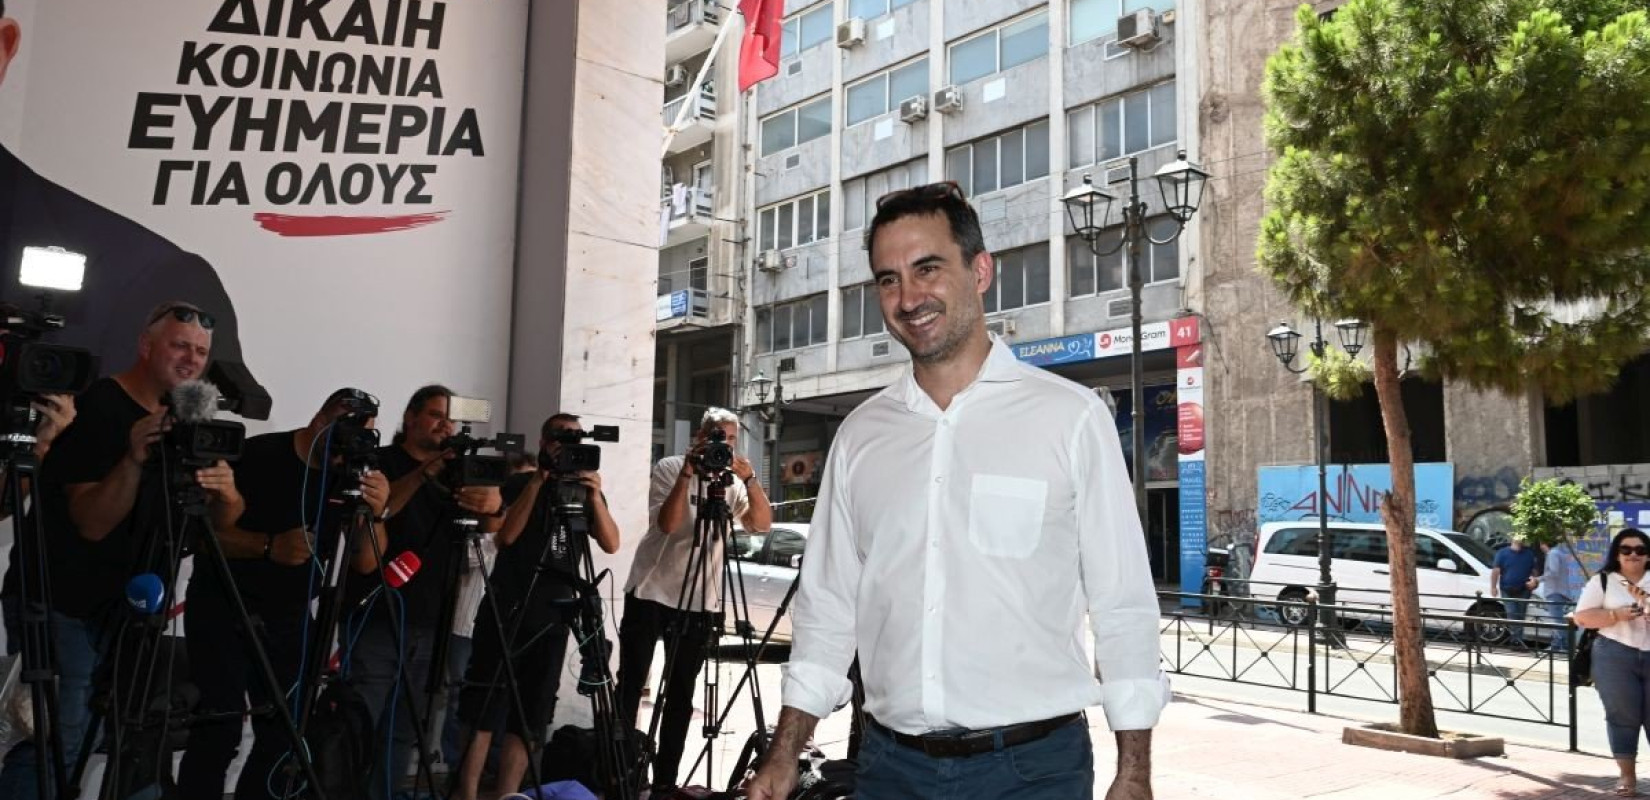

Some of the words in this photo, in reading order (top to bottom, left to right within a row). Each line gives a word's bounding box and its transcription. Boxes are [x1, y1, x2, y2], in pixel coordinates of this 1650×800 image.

[207, 0, 446, 49] ΔΙΚΑΙΗ
[176, 41, 443, 98] ΚΟΙΝΩΝΙΑ
[127, 92, 485, 156] ΕΥΗΜΕΡΙΑ
[152, 160, 249, 205] ΓΙΑ
[264, 162, 437, 205] ΟΛΟΥΣ
[1019, 340, 1065, 358] ELEANNA
[1114, 331, 1166, 344] MonGram
[1177, 326, 1191, 338] 41
